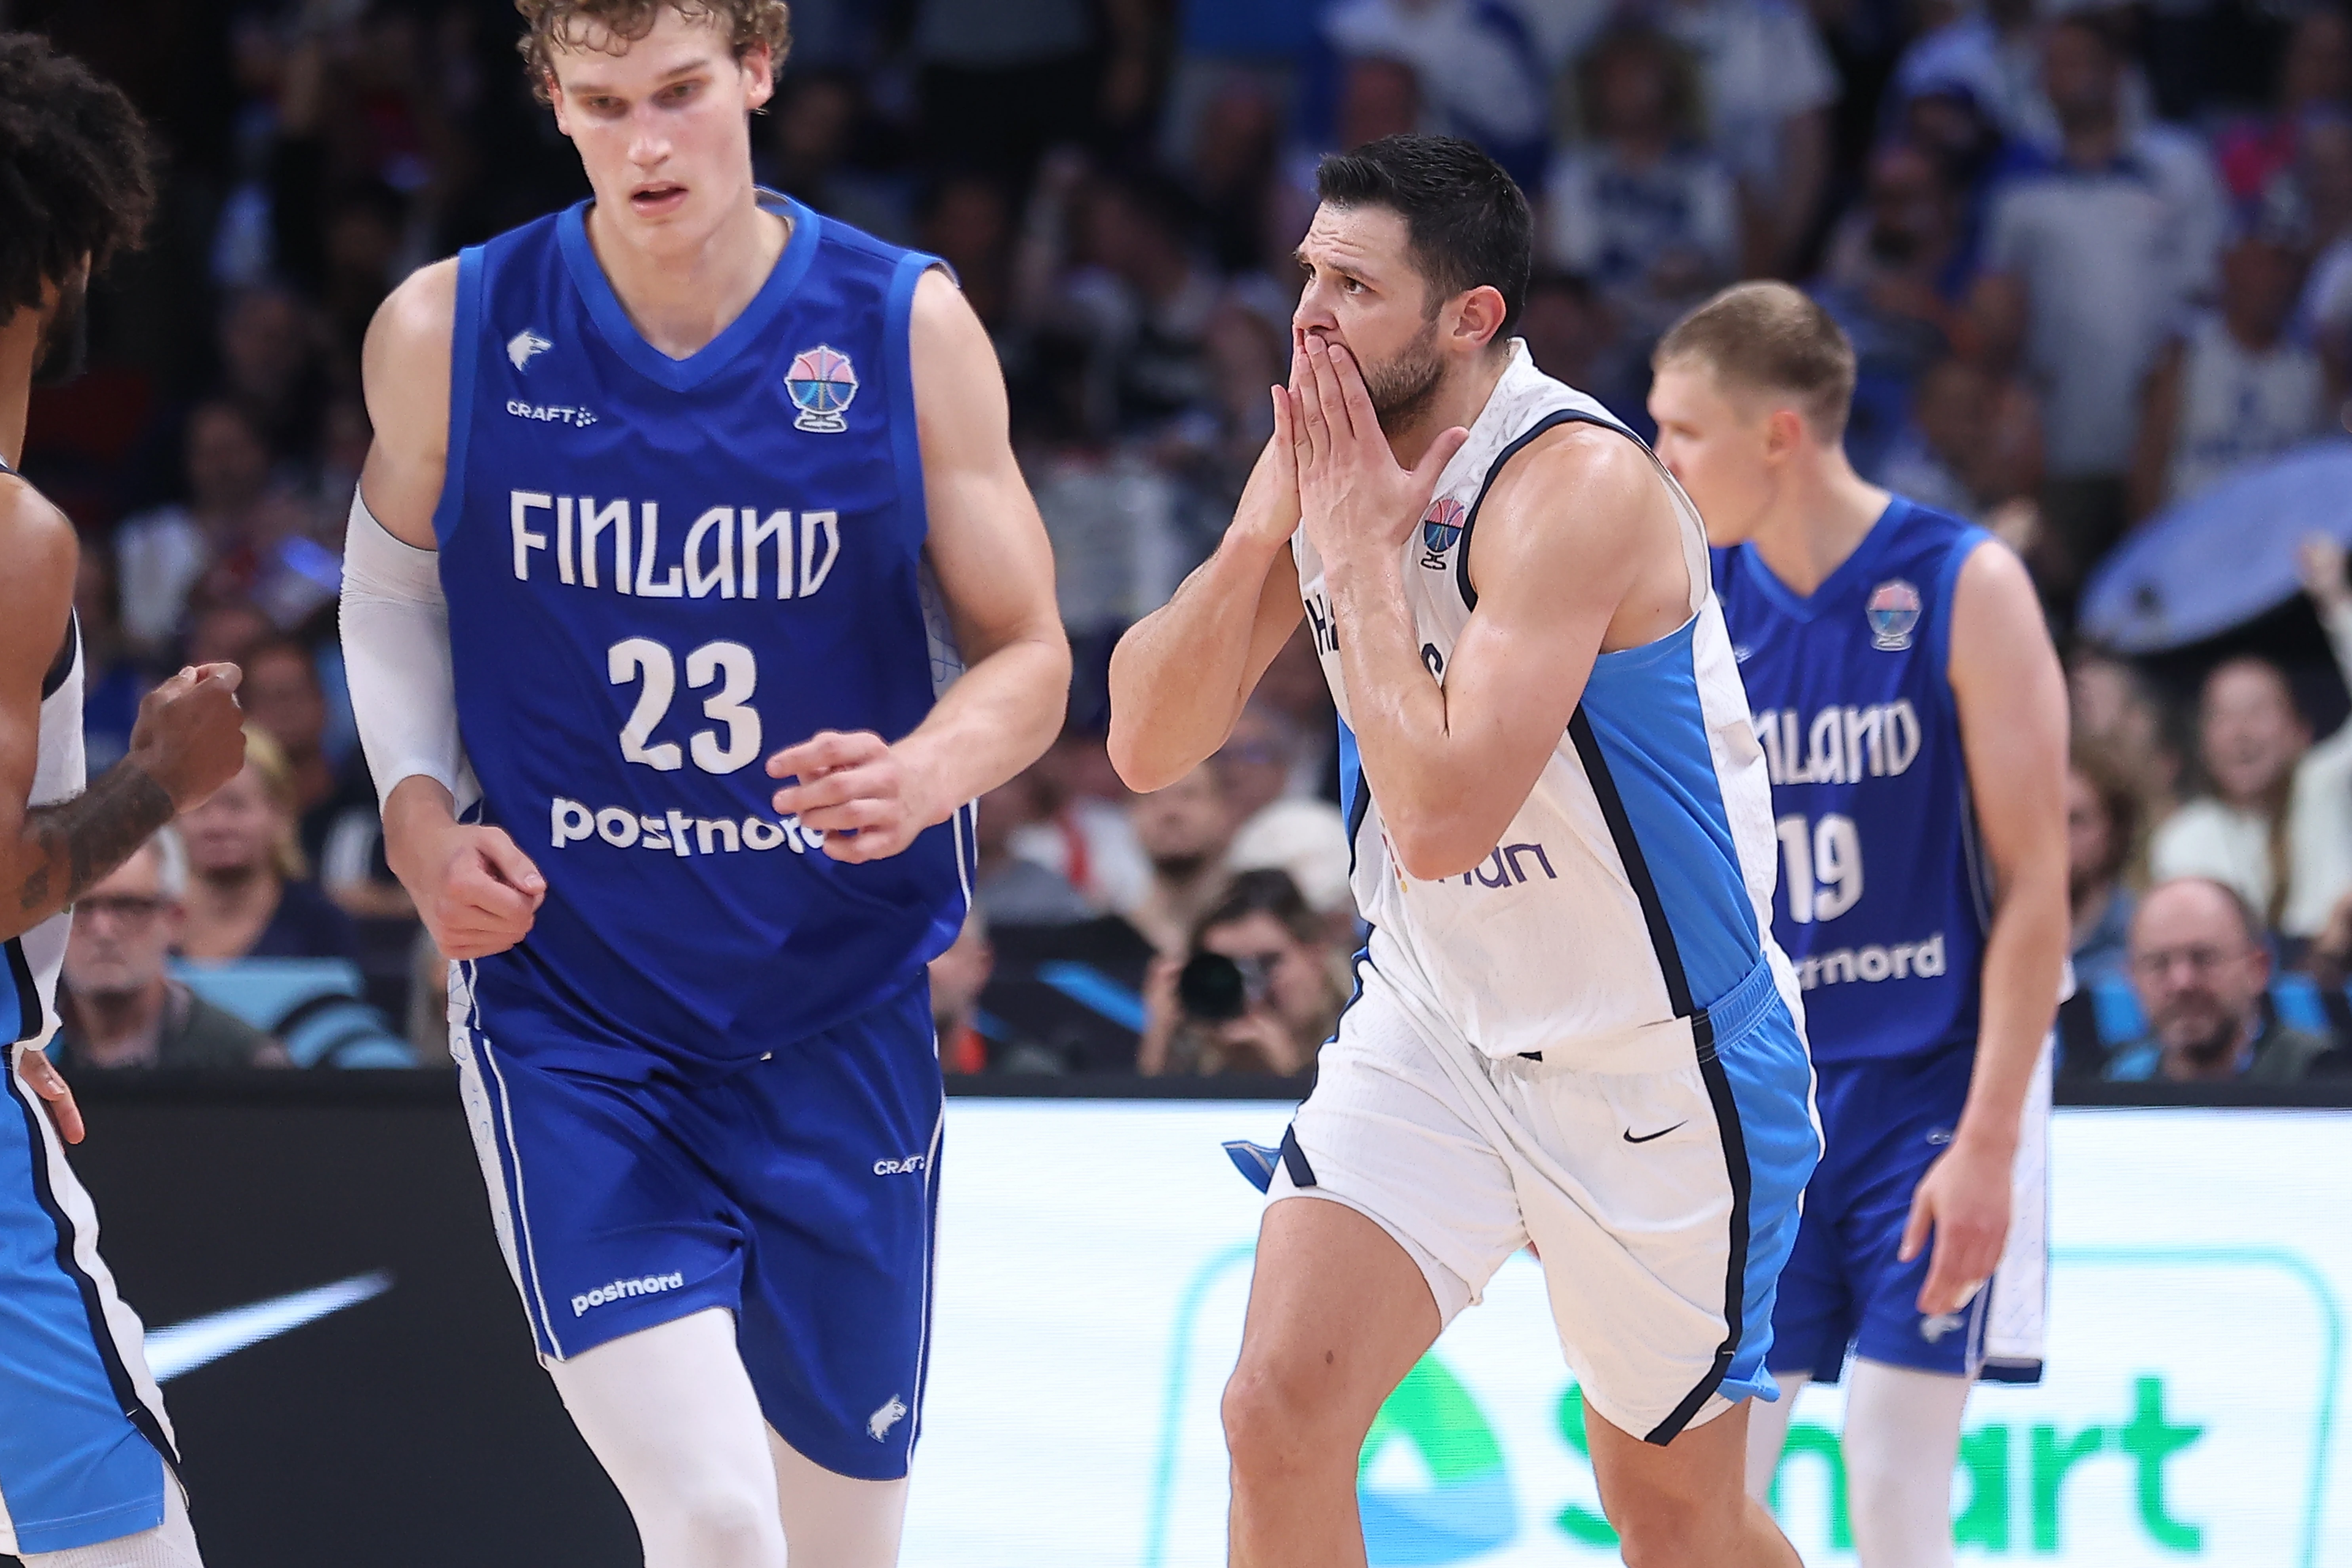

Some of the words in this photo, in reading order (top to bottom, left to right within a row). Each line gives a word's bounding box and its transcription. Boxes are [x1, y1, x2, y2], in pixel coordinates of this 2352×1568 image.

[507, 401, 575, 423] CRAFT
[608, 638, 762, 774] 23
[1750, 699, 1921, 785] NLAND
[1777, 813, 1863, 924] 19
[571, 1272, 684, 1317] postnord
